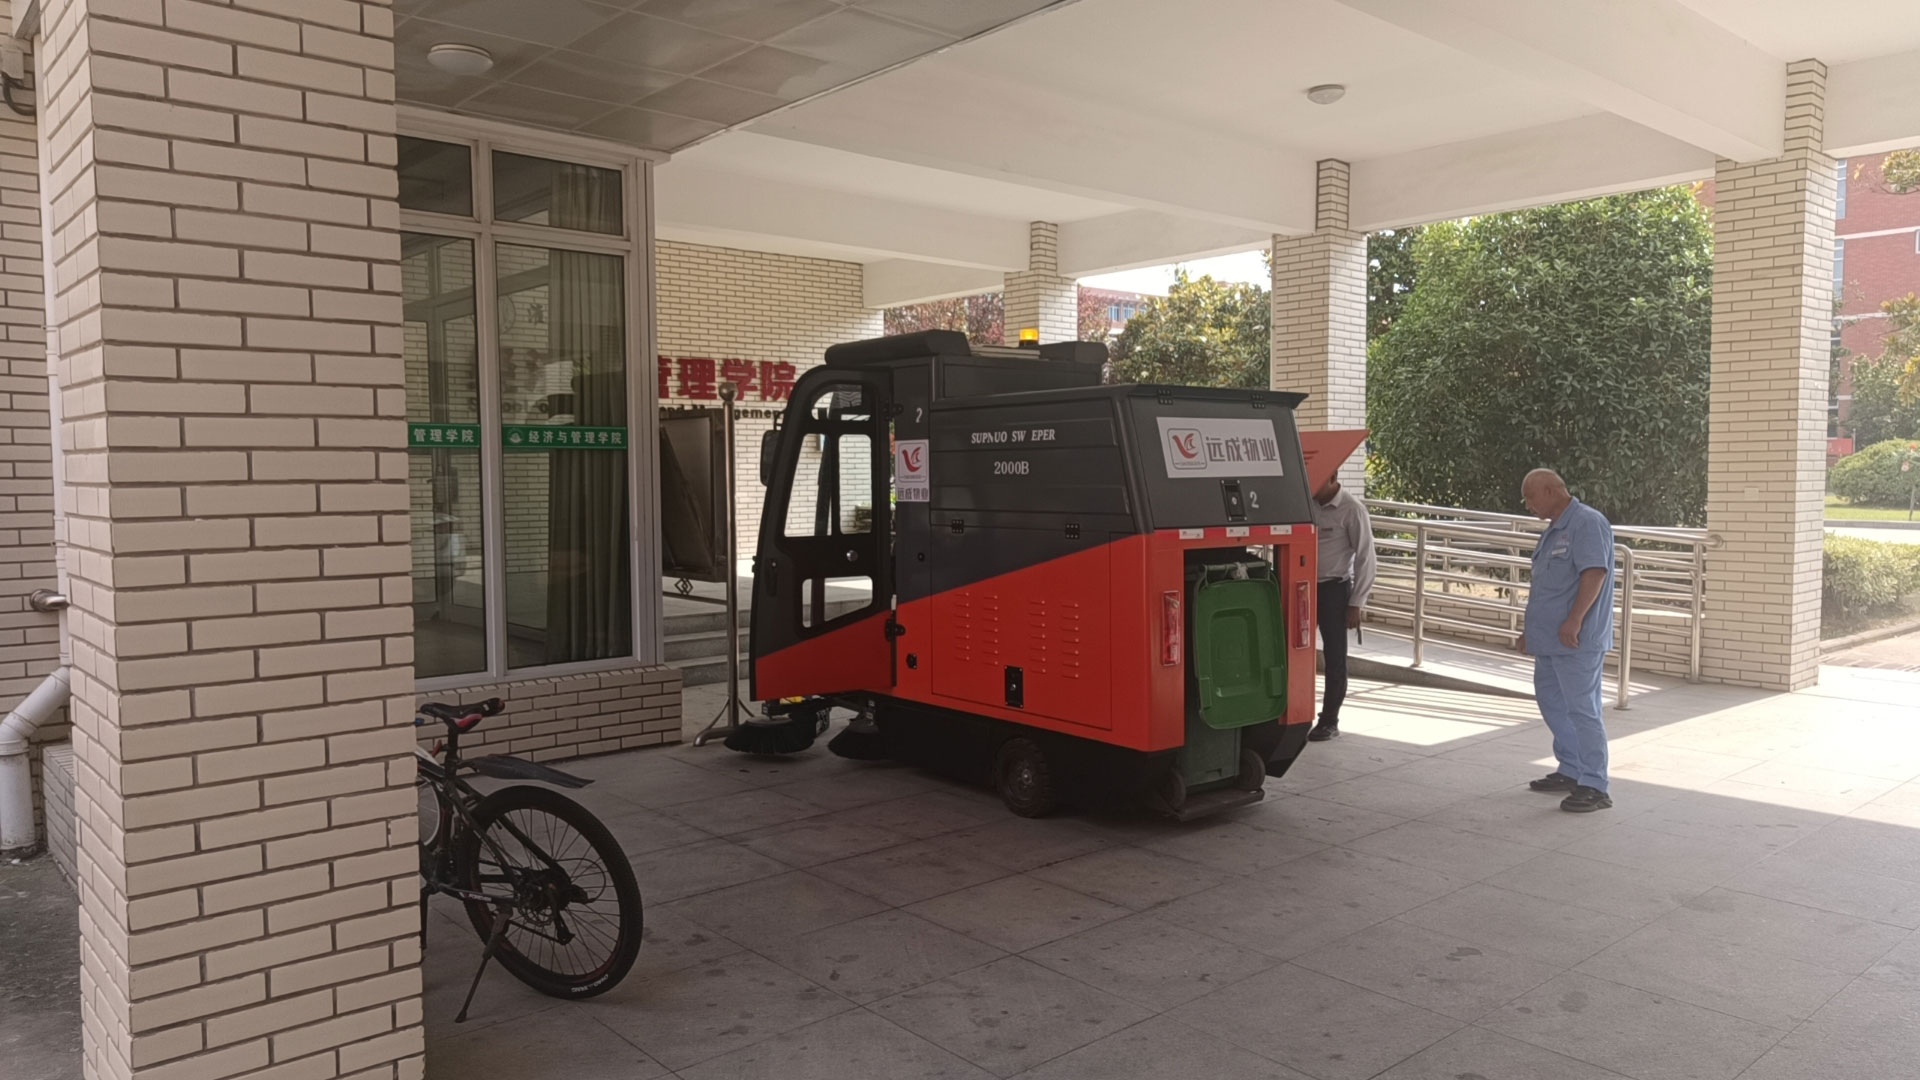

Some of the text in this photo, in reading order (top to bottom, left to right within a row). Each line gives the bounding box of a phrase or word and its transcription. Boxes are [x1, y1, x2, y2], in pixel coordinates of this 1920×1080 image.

[916, 407, 923, 423] 2
[413, 428, 475, 443] 管理学院
[528, 430, 622, 444] 经济与管理学院
[971, 430, 1008, 444] SUPNUO
[1205, 436, 1278, 462] 远成物业
[993, 460, 1030, 475] 2000B
[1249, 491, 1259, 508] 2
